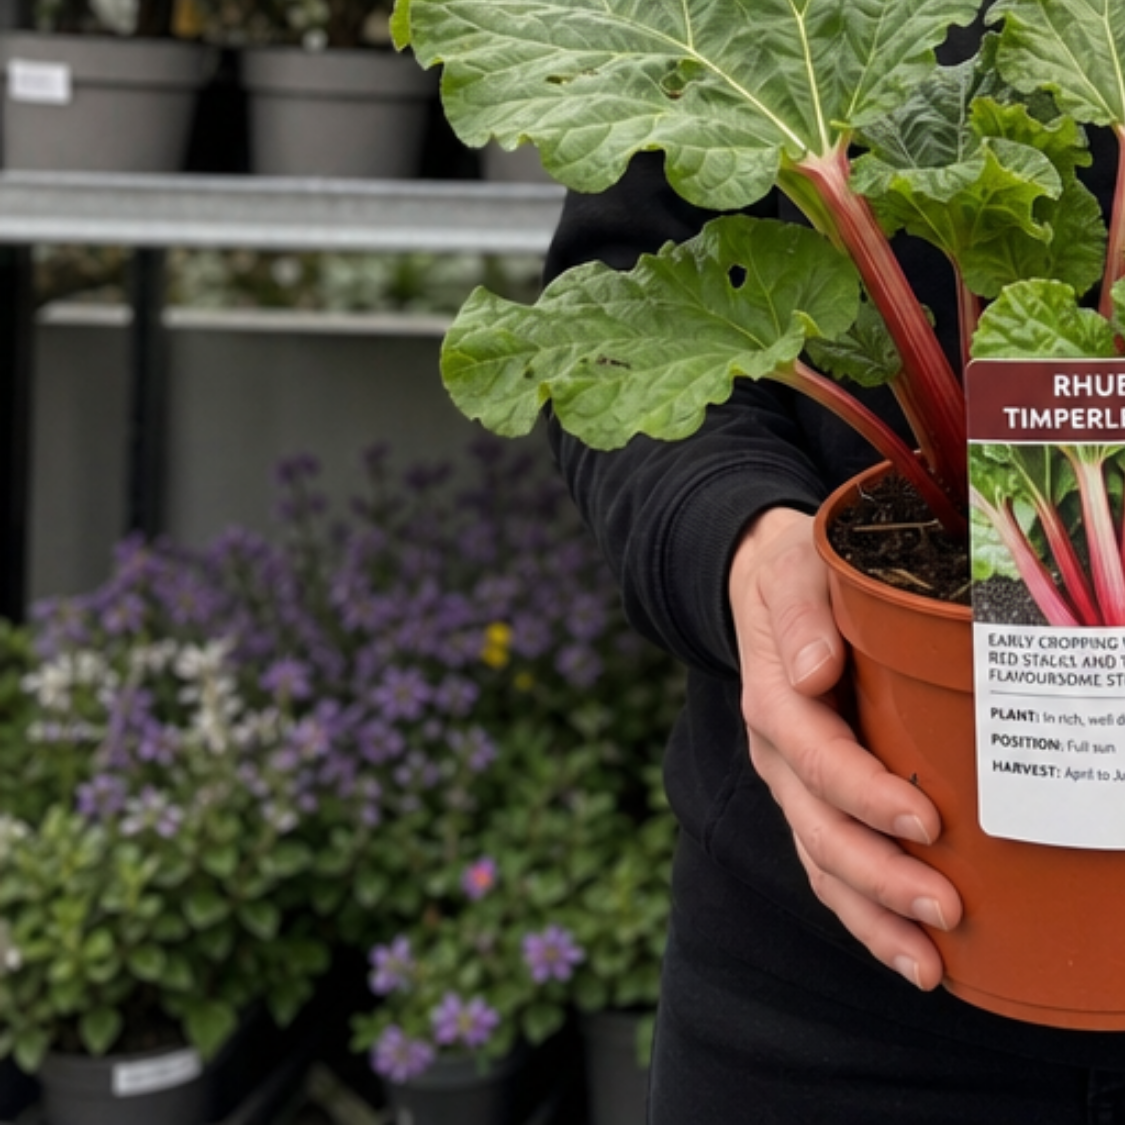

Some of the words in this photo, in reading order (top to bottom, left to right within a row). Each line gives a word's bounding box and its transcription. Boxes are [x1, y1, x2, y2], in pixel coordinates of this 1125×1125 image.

[988, 632, 1034, 649] EARLY
[1038, 636, 1119, 650] CROPPING
[988, 651, 1018, 667] RED
[1082, 654, 1117, 670] AND
[990, 707, 1040, 723] PLANT:
[991, 733, 1064, 752] POSITION:
[1067, 738, 1089, 753] Full
[992, 760, 1061, 779] HARVEST:
[1064, 766, 1095, 782] April
[1096, 770, 1110, 781] to
